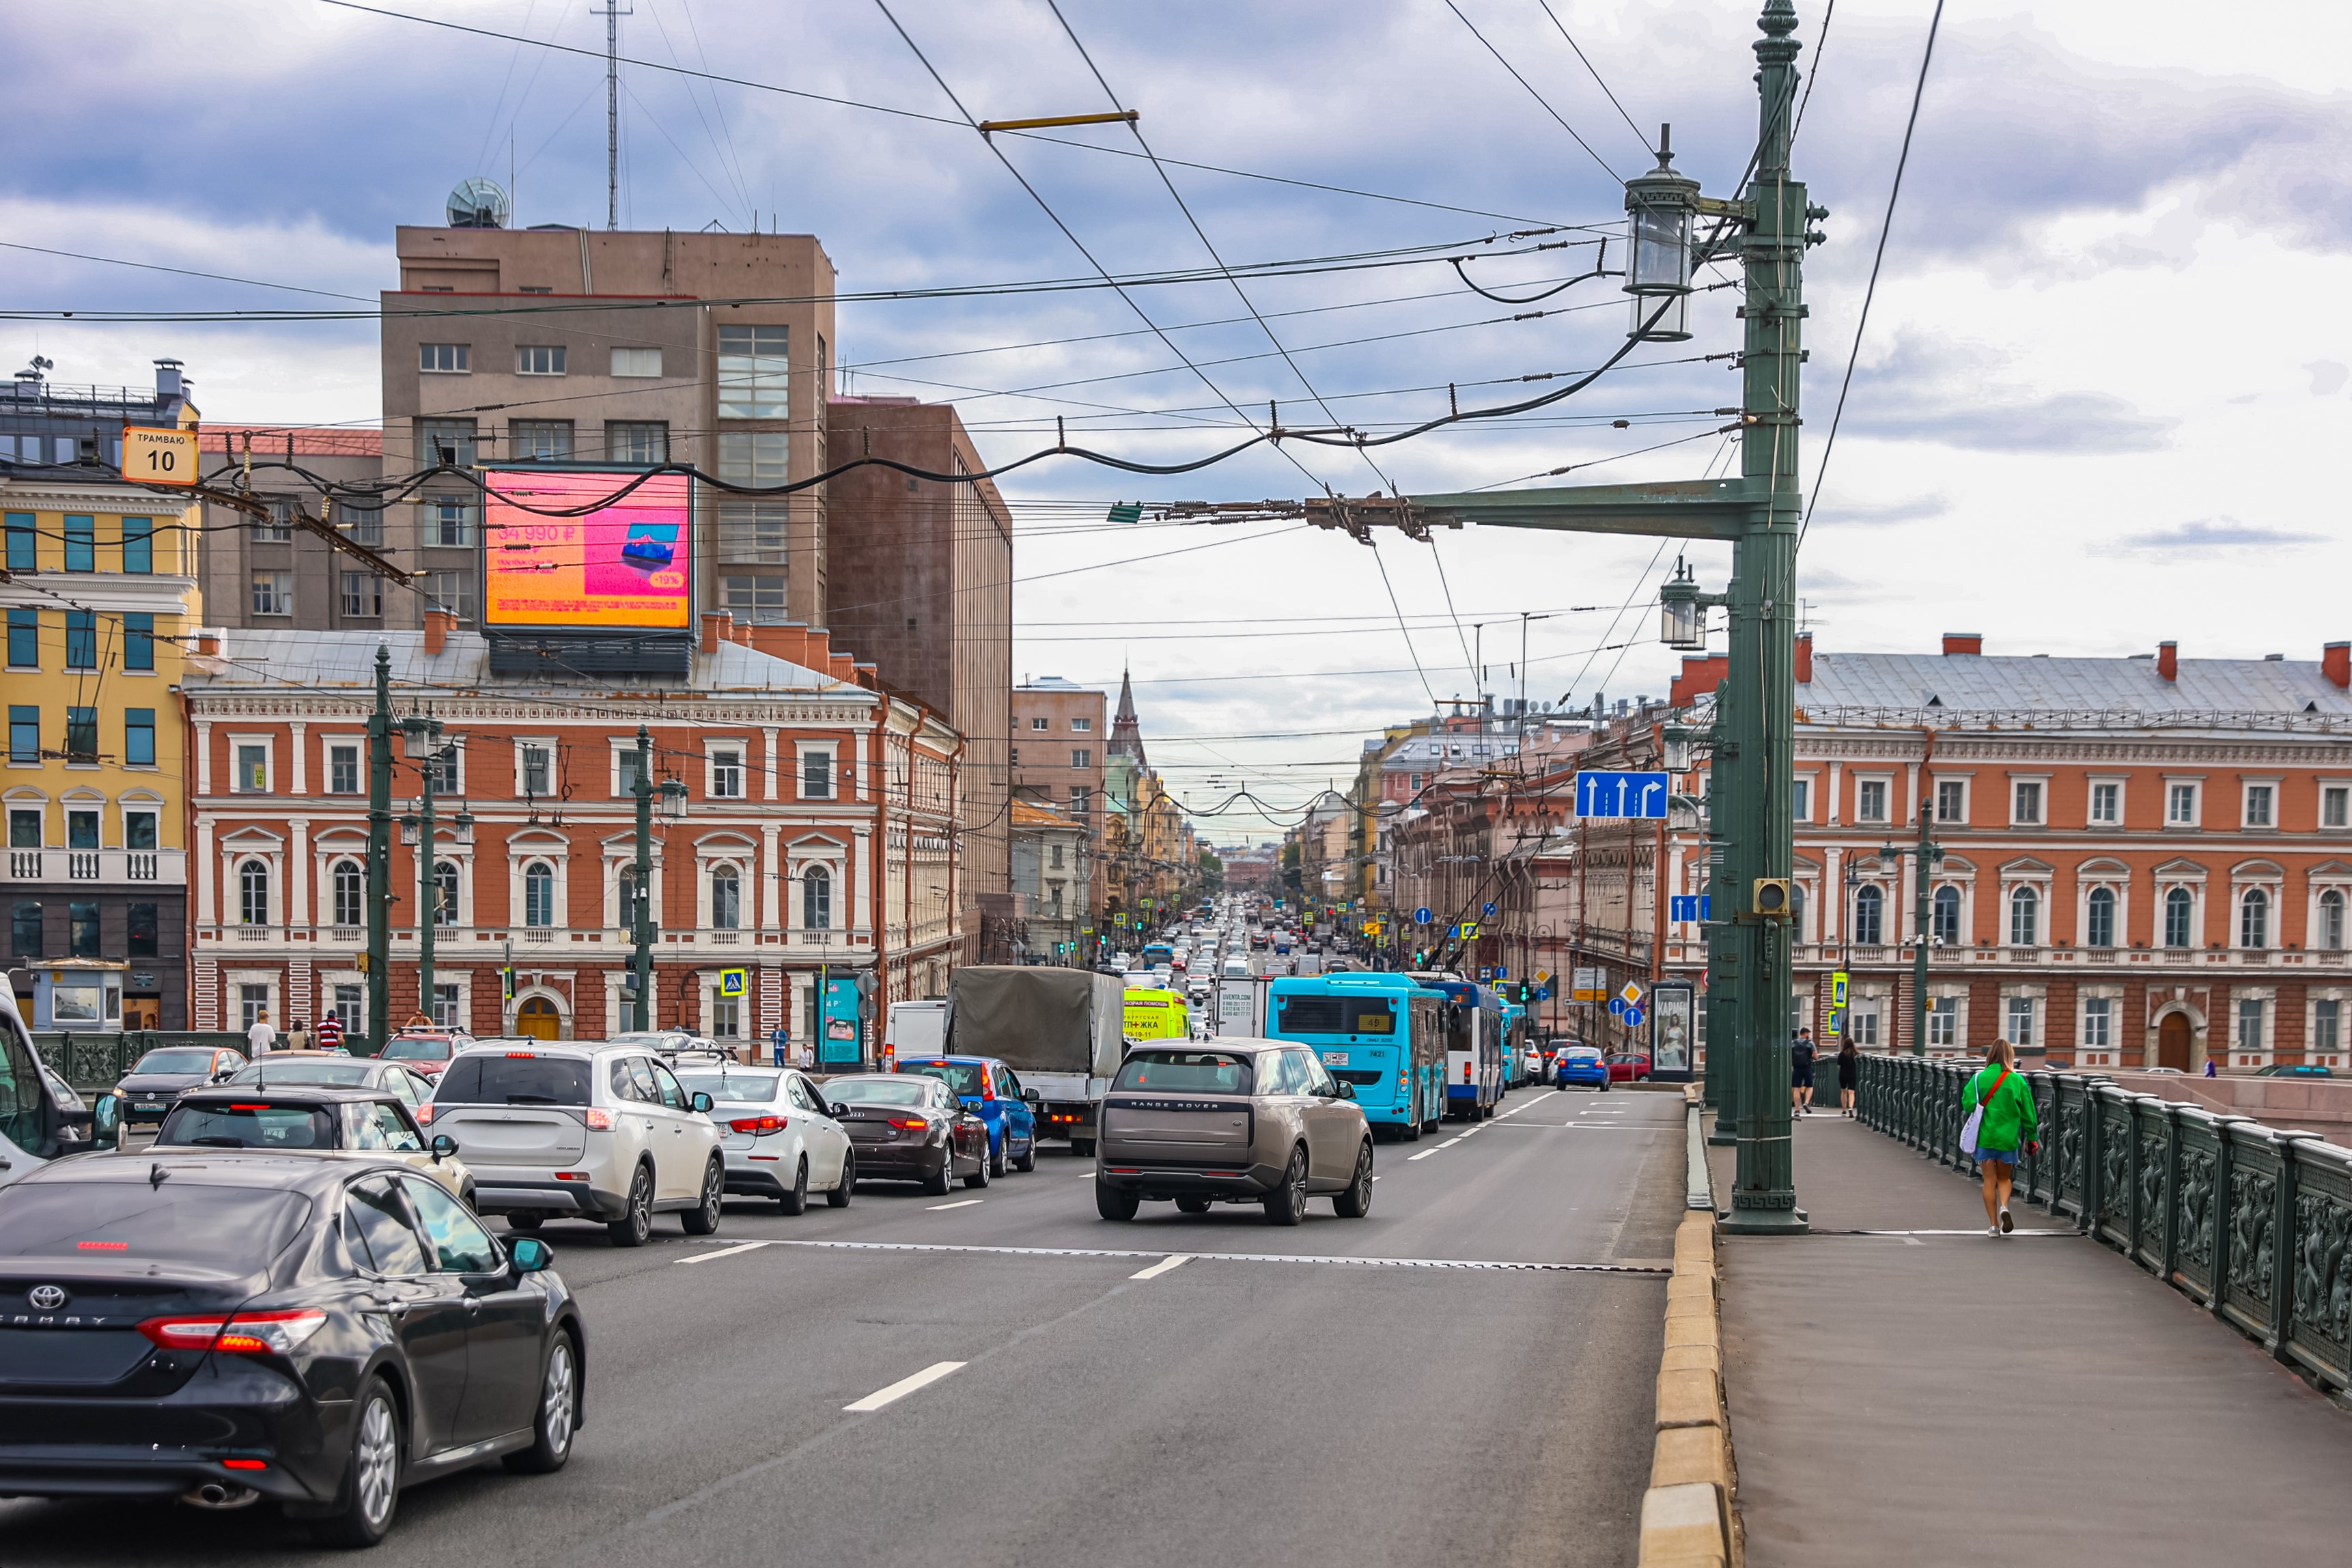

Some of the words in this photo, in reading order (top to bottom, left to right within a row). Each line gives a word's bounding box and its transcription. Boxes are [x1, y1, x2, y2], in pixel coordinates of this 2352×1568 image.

[137, 434, 185, 445] ТРАМВАЮ
[148, 450, 175, 471] 10
[525, 526, 558, 541] 990
[655, 575, 679, 585] -19%
